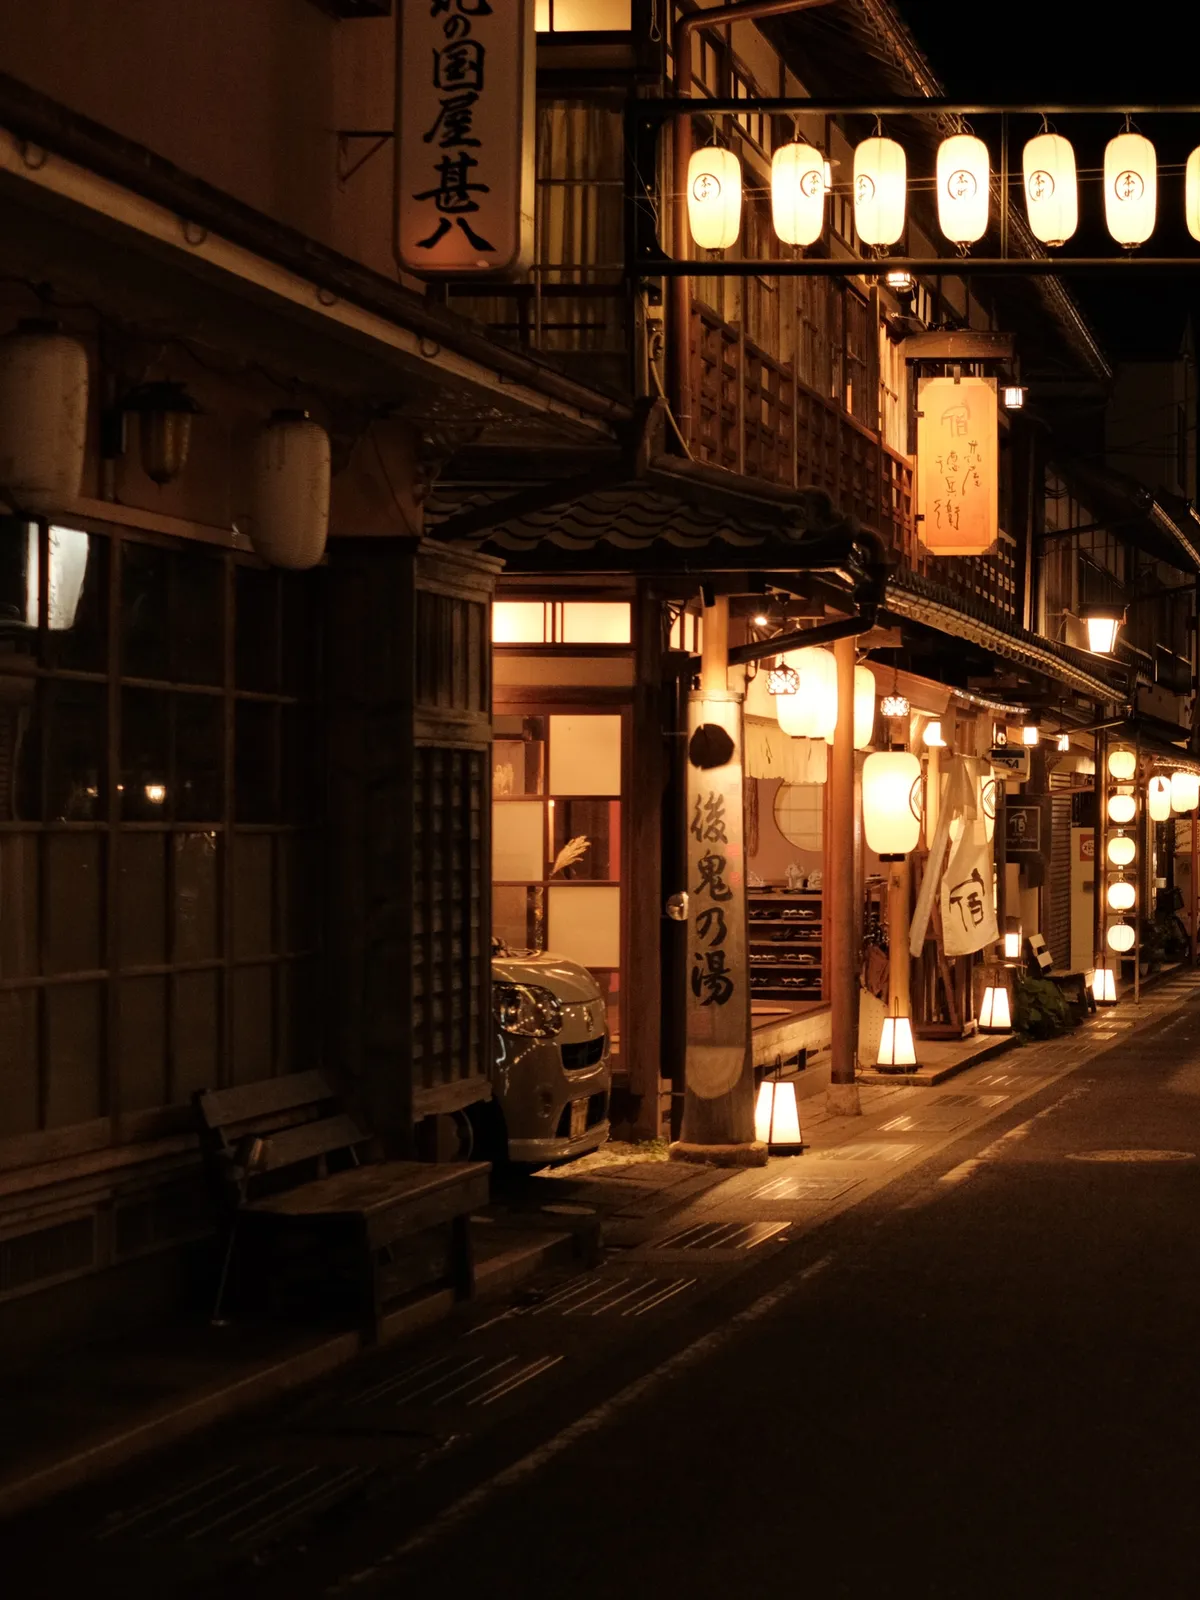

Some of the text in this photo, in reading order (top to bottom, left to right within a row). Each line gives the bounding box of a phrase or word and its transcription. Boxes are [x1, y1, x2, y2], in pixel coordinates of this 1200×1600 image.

[941, 402, 970, 437] 宿
[690, 791, 734, 1006] 後鬼乃湯
[949, 868, 986, 932] 宿
